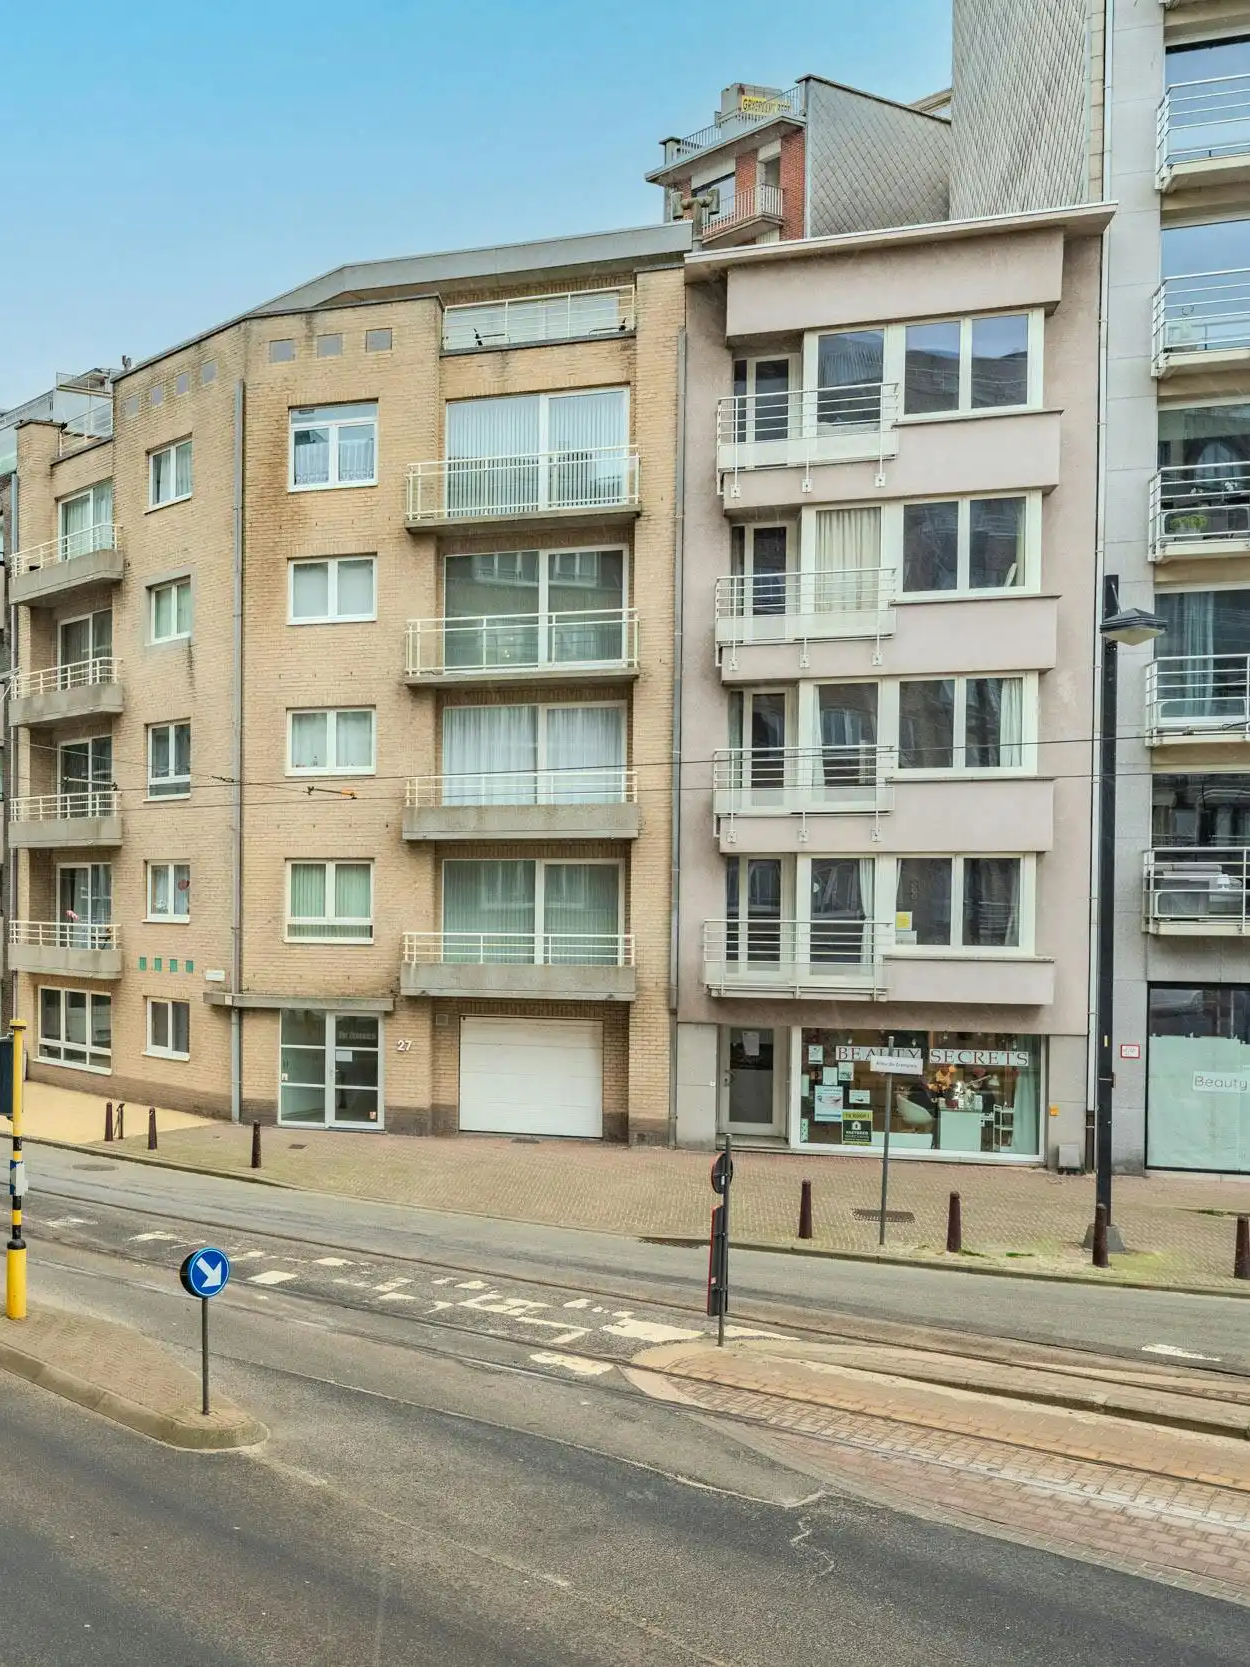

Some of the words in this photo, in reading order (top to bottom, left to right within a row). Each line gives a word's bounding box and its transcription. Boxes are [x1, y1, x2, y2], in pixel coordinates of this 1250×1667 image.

[397, 1039, 412, 1052] 27
[930, 1049, 1028, 1066] SECRETS
[1195, 1076, 1247, 1091] Beauty
